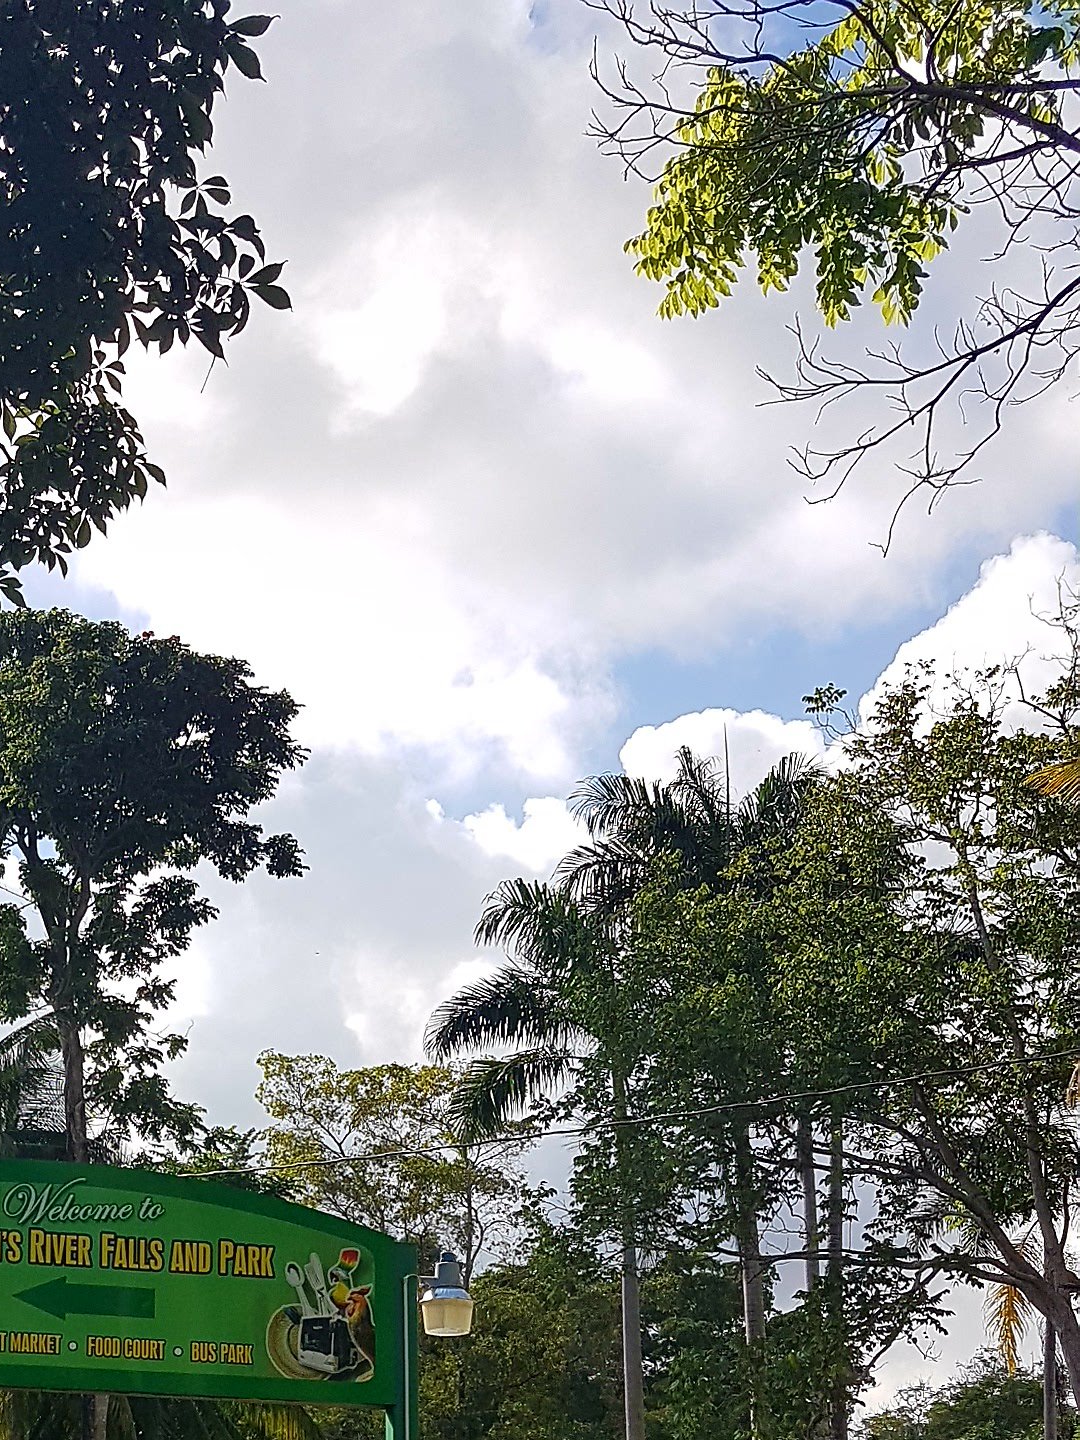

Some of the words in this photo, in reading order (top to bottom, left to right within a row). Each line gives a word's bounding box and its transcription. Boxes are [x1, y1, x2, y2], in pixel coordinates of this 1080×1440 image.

[3, 1177, 133, 1224] Welcome
[139, 1197, 165, 1220] to
[29, 1229, 92, 1267] RIVER
[101, 1233, 164, 1271] FALLS
[170, 1240, 212, 1274] AND
[219, 1240, 274, 1277] PARK
[10, 1332, 62, 1354] MARKET
[87, 1336, 121, 1358] FOOD
[124, 1338, 166, 1360] COURT
[191, 1342, 217, 1362] BUS
[220, 1343, 253, 1364] PARK
